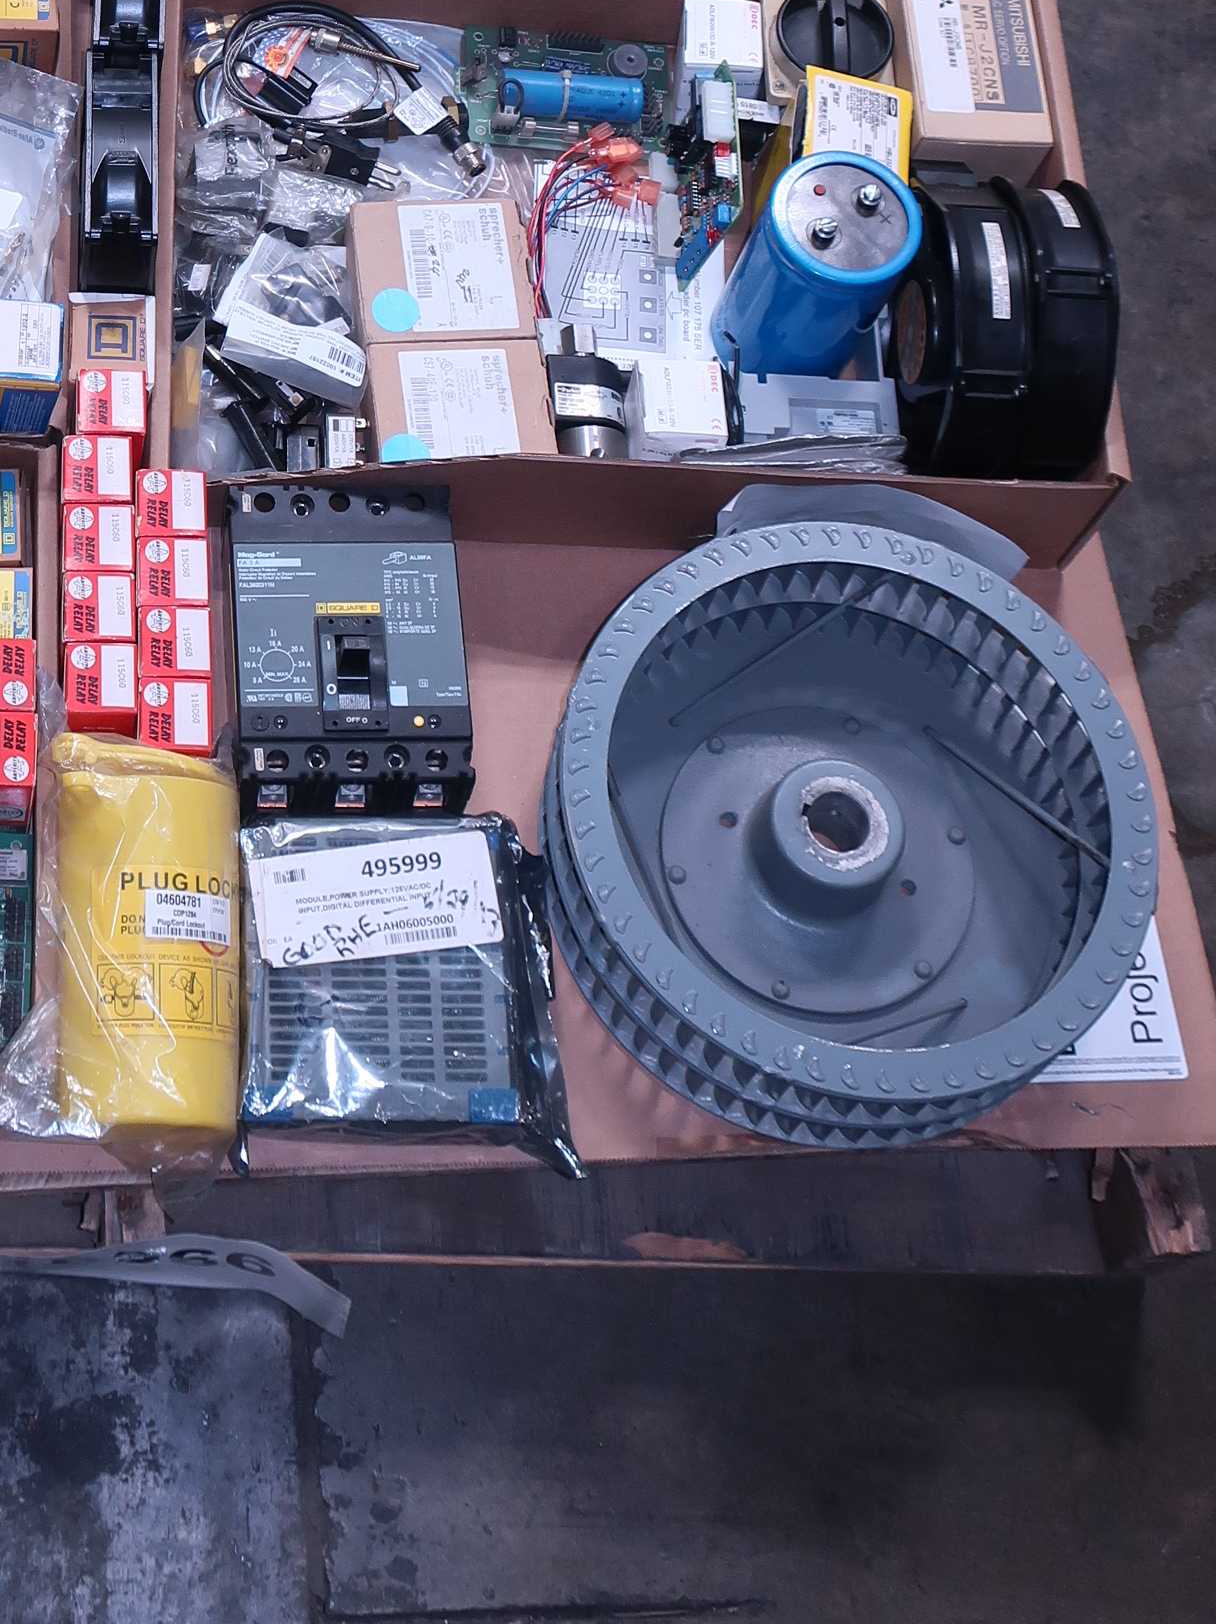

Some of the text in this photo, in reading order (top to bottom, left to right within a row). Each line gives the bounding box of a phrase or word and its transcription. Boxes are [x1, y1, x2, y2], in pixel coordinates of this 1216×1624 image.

[750, 9, 759, 30] IDEC
[972, 5, 1001, 101] MR-J2CNS
[478, 208, 492, 241] schuh
[481, 355, 494, 391] schuh
[709, 371, 719, 393] IDEC
[147, 499, 156, 526] RELAY
[158, 501, 168, 527] DELAY
[149, 568, 158, 596] RELAY
[160, 570, 170, 597] DELAY
[73, 604, 83, 632] RELAY
[85, 605, 95, 633] DELAY
[328, 604, 366, 613] SQUARE
[3, 645, 13, 674] DELAY
[14, 646, 25, 676] RELAY
[151, 638, 161, 667] RELAY
[163, 639, 172, 668] DELAY
[76, 674, 86, 704] RELAY
[88, 675, 98, 704] DELAY
[4, 719, 14, 749] DELAY
[149, 712, 159, 740] RELAY
[161, 714, 172, 743] DELAY
[346, 716, 360, 724] OFF
[16, 720, 26, 751] RELAY
[361, 851, 442, 878] 495999
[121, 871, 188, 892] PLUG
[156, 892, 201, 908] 04604781
[354, 894, 408, 908] DIFFERENTIAL
[121, 925, 145, 935] PLU
[1127, 951, 1164, 1044] Proje
